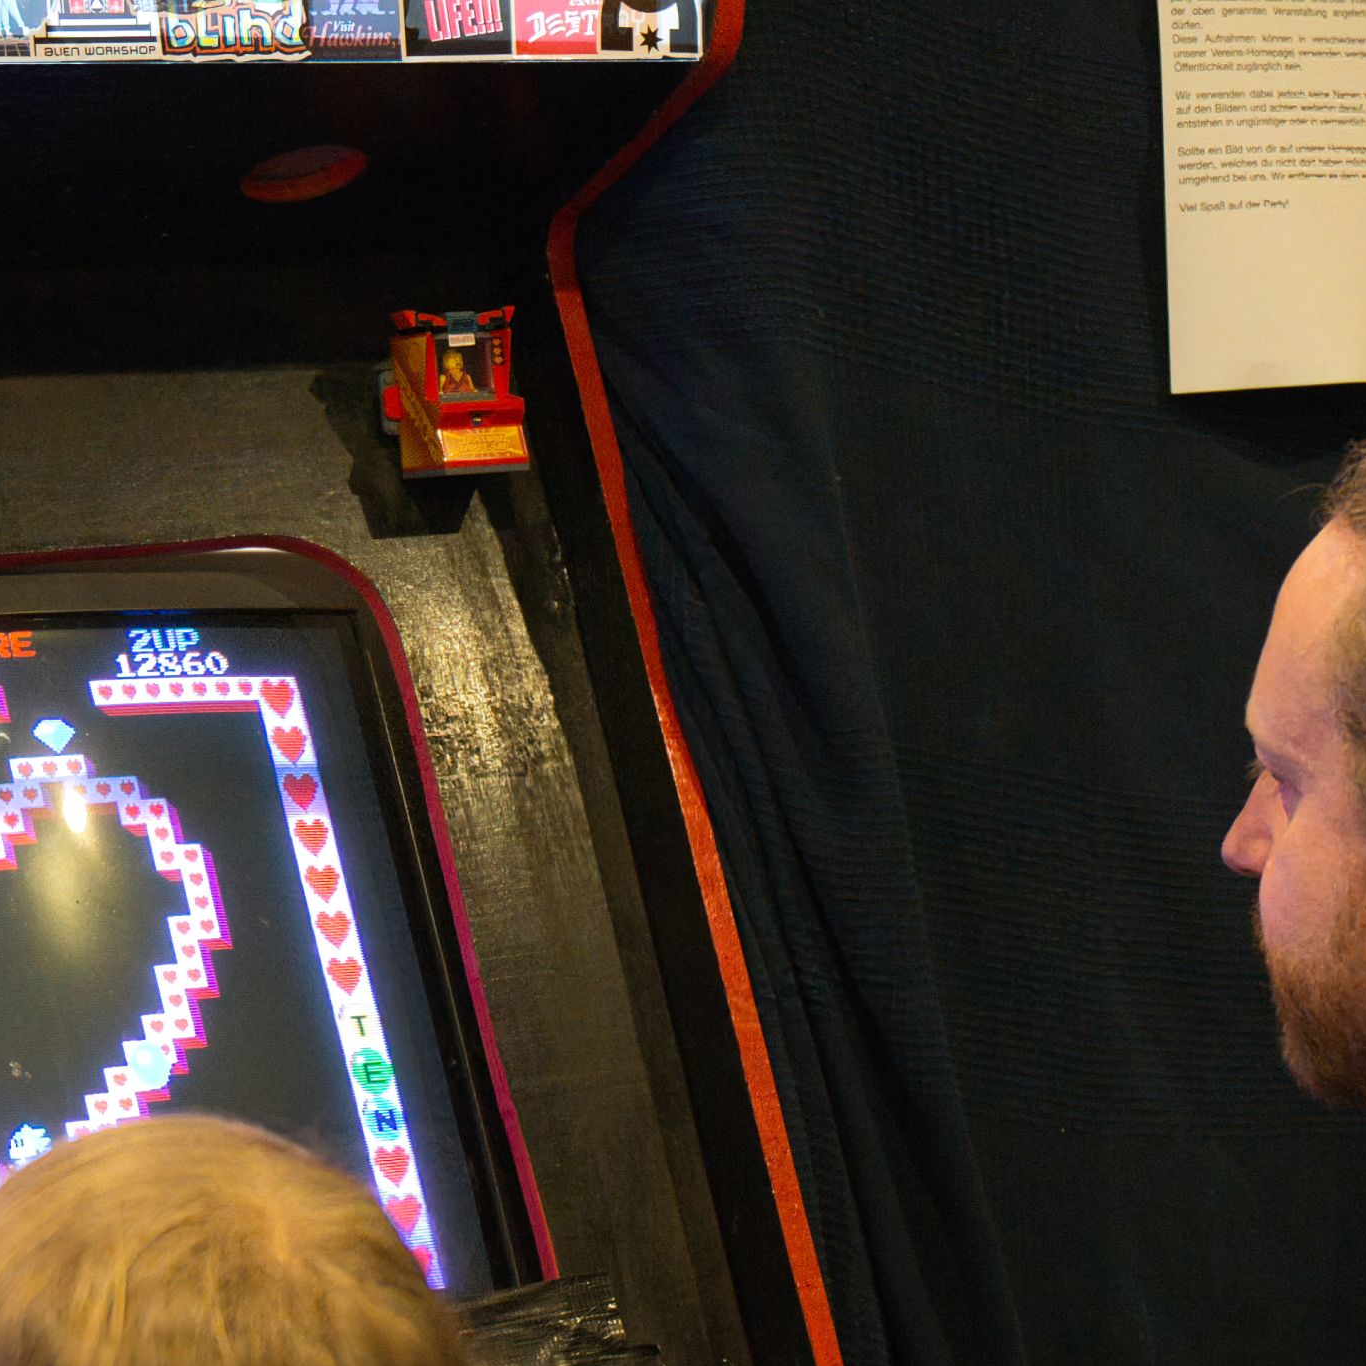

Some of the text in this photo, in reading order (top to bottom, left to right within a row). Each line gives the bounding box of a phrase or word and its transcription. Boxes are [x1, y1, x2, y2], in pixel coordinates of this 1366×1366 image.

[333, 20, 356, 33] Visit
[85, 45, 156, 57] WORKSHOP
[127, 627, 201, 653] 2UP
[115, 651, 230, 678] 12860
